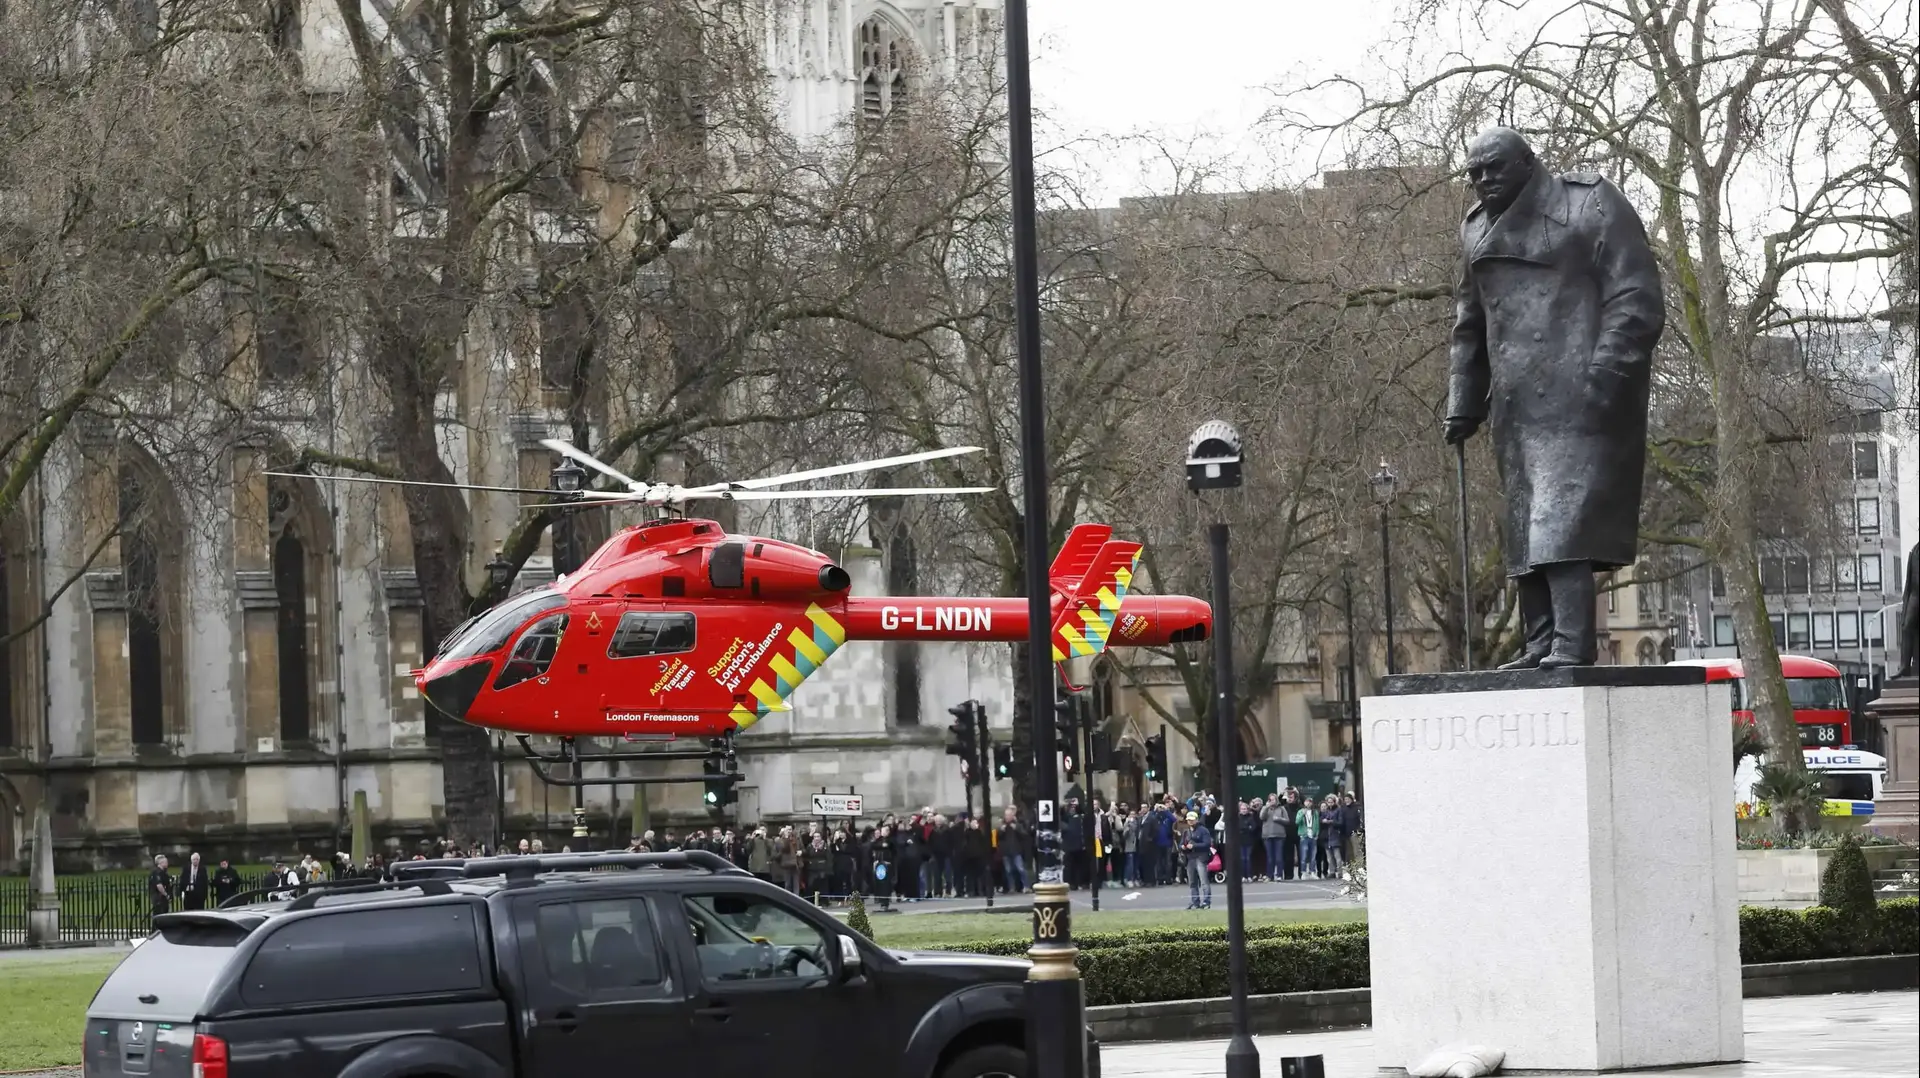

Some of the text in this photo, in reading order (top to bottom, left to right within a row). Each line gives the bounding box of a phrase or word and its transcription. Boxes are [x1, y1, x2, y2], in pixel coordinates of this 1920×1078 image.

[881, 606, 992, 631] G-LNDN
[707, 637, 743, 677] Support
[715, 641, 755, 686] London's
[726, 622, 783, 693] Air Ambulance
[650, 657, 682, 696] Advanced
[662, 664, 689, 692] Trauma
[675, 669, 696, 690] Team
[606, 712, 700, 722] London Freemasons
[1371, 711, 1580, 752] CHURCHILL
[1818, 727, 1835, 741] 88
[1804, 756, 1861, 764] LICE
